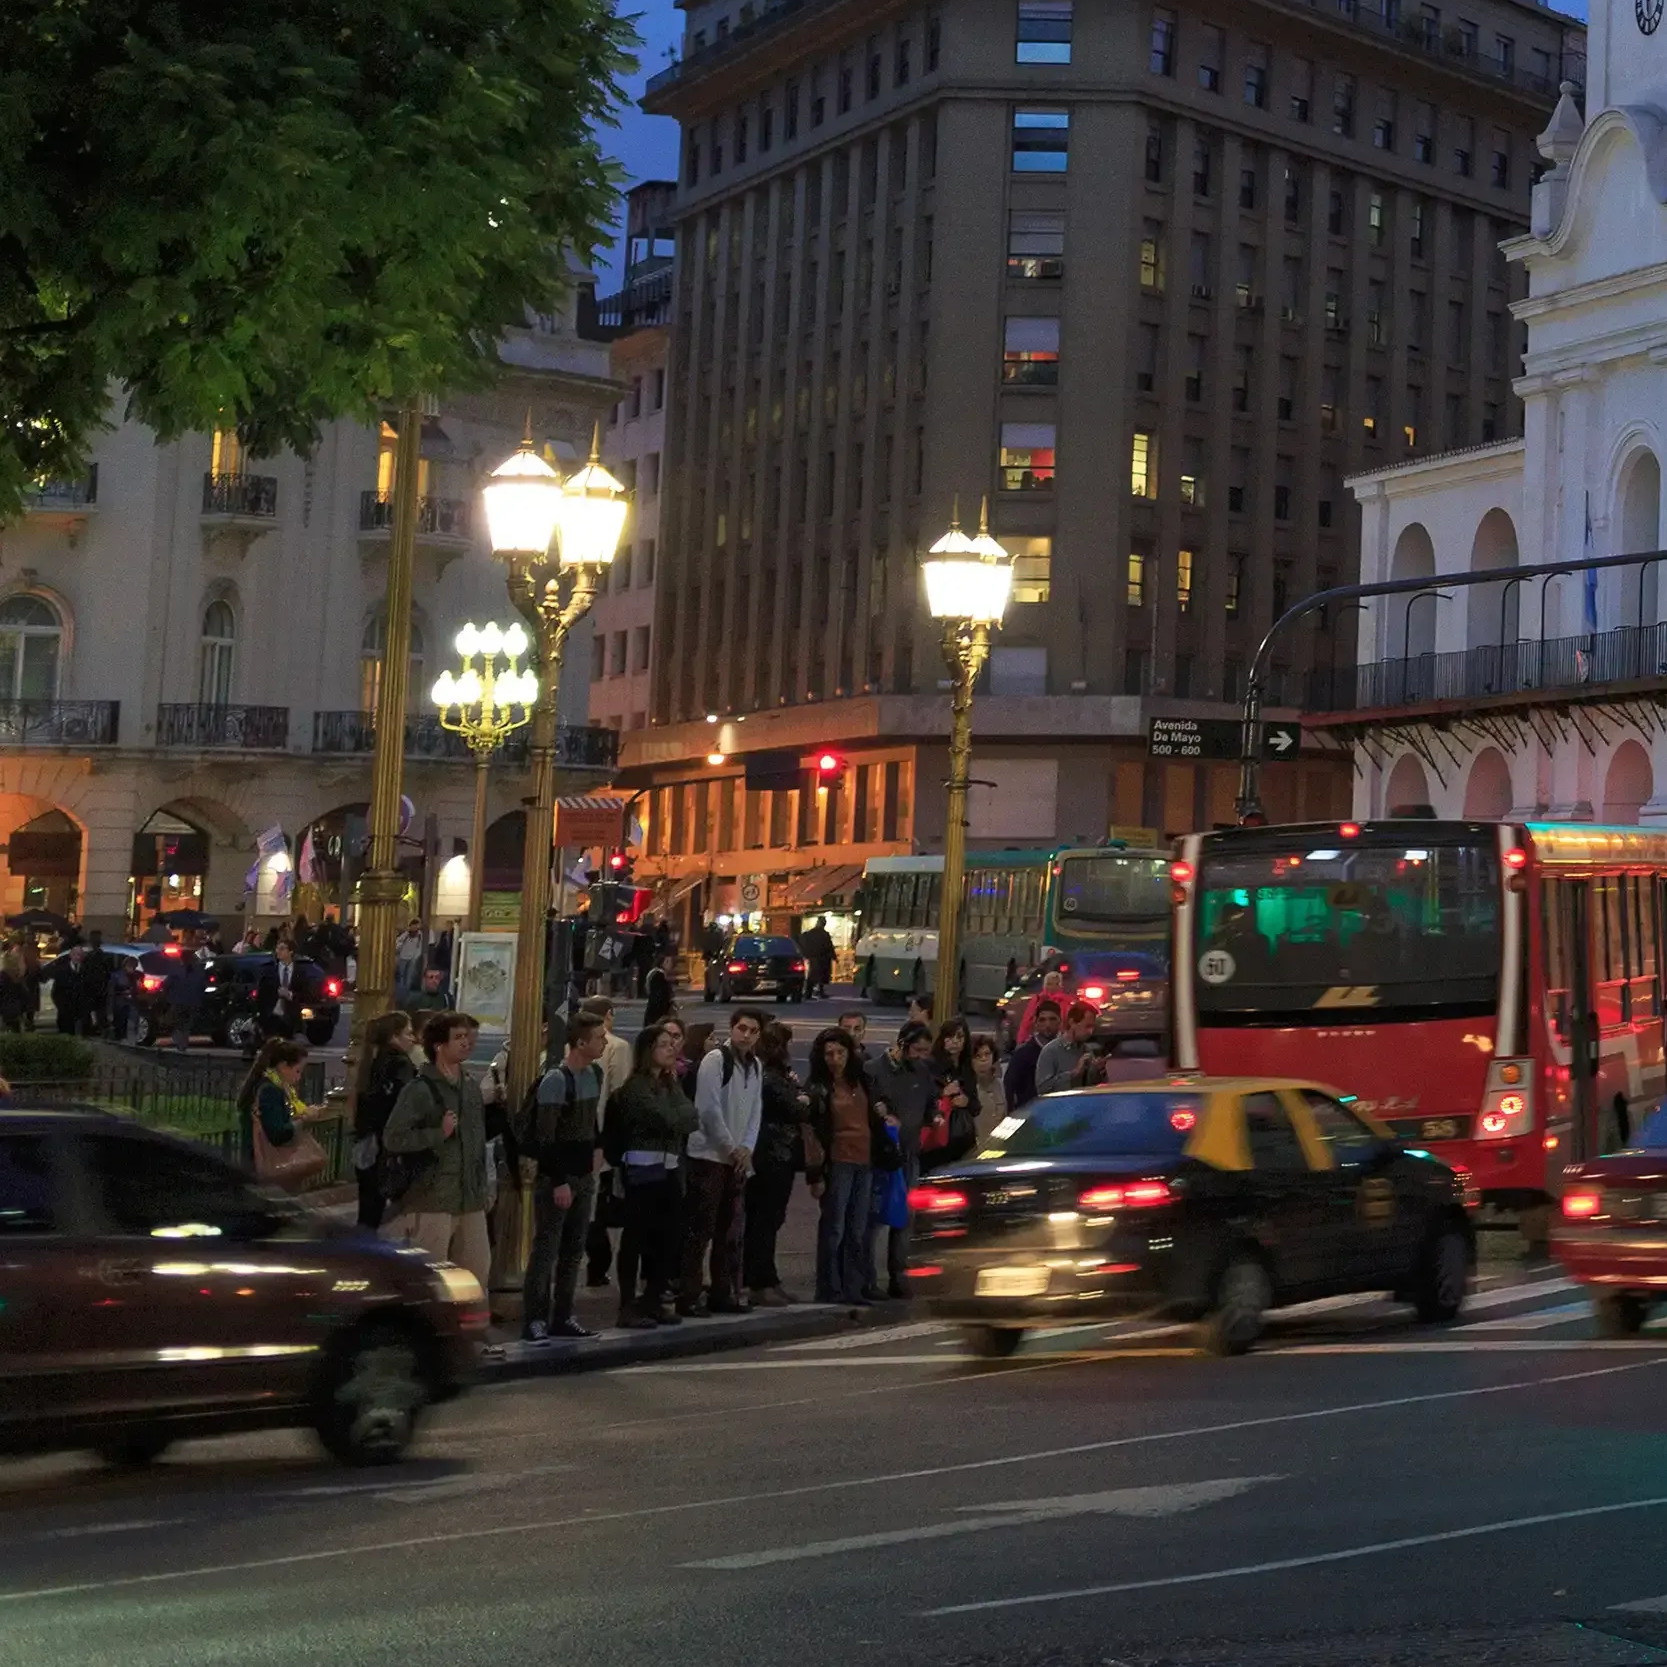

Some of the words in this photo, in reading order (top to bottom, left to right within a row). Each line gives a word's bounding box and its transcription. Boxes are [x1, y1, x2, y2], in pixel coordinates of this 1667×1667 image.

[1153, 720, 1198, 730] Avenida
[1170, 732, 1202, 744] Mayo
[1152, 744, 1172, 754] 500
[1181, 745, 1201, 755] 600
